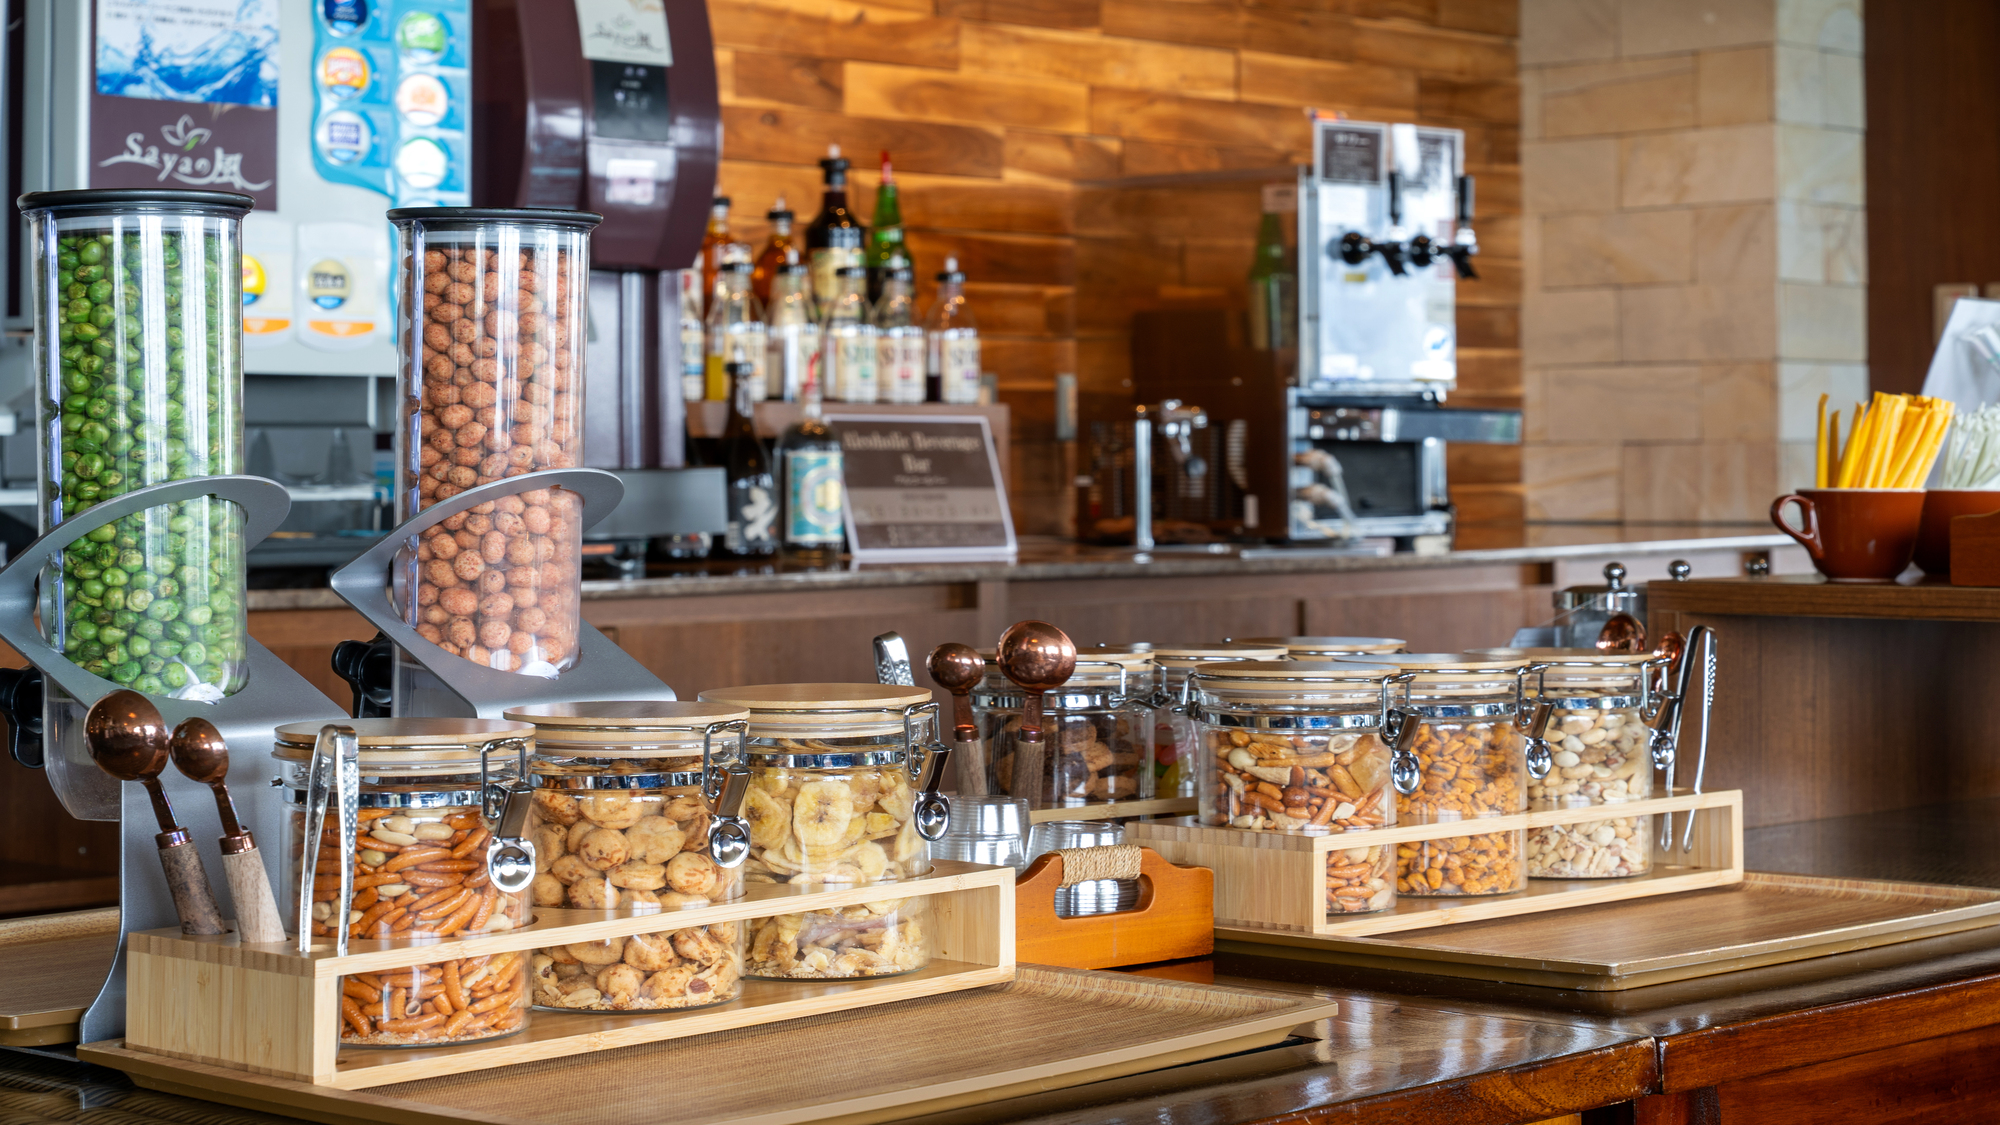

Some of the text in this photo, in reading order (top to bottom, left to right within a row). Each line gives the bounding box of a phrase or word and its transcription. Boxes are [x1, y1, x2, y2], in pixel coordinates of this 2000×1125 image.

[843, 430, 979, 452] Alcoholic Beverage
[902, 453, 932, 474] Bar
